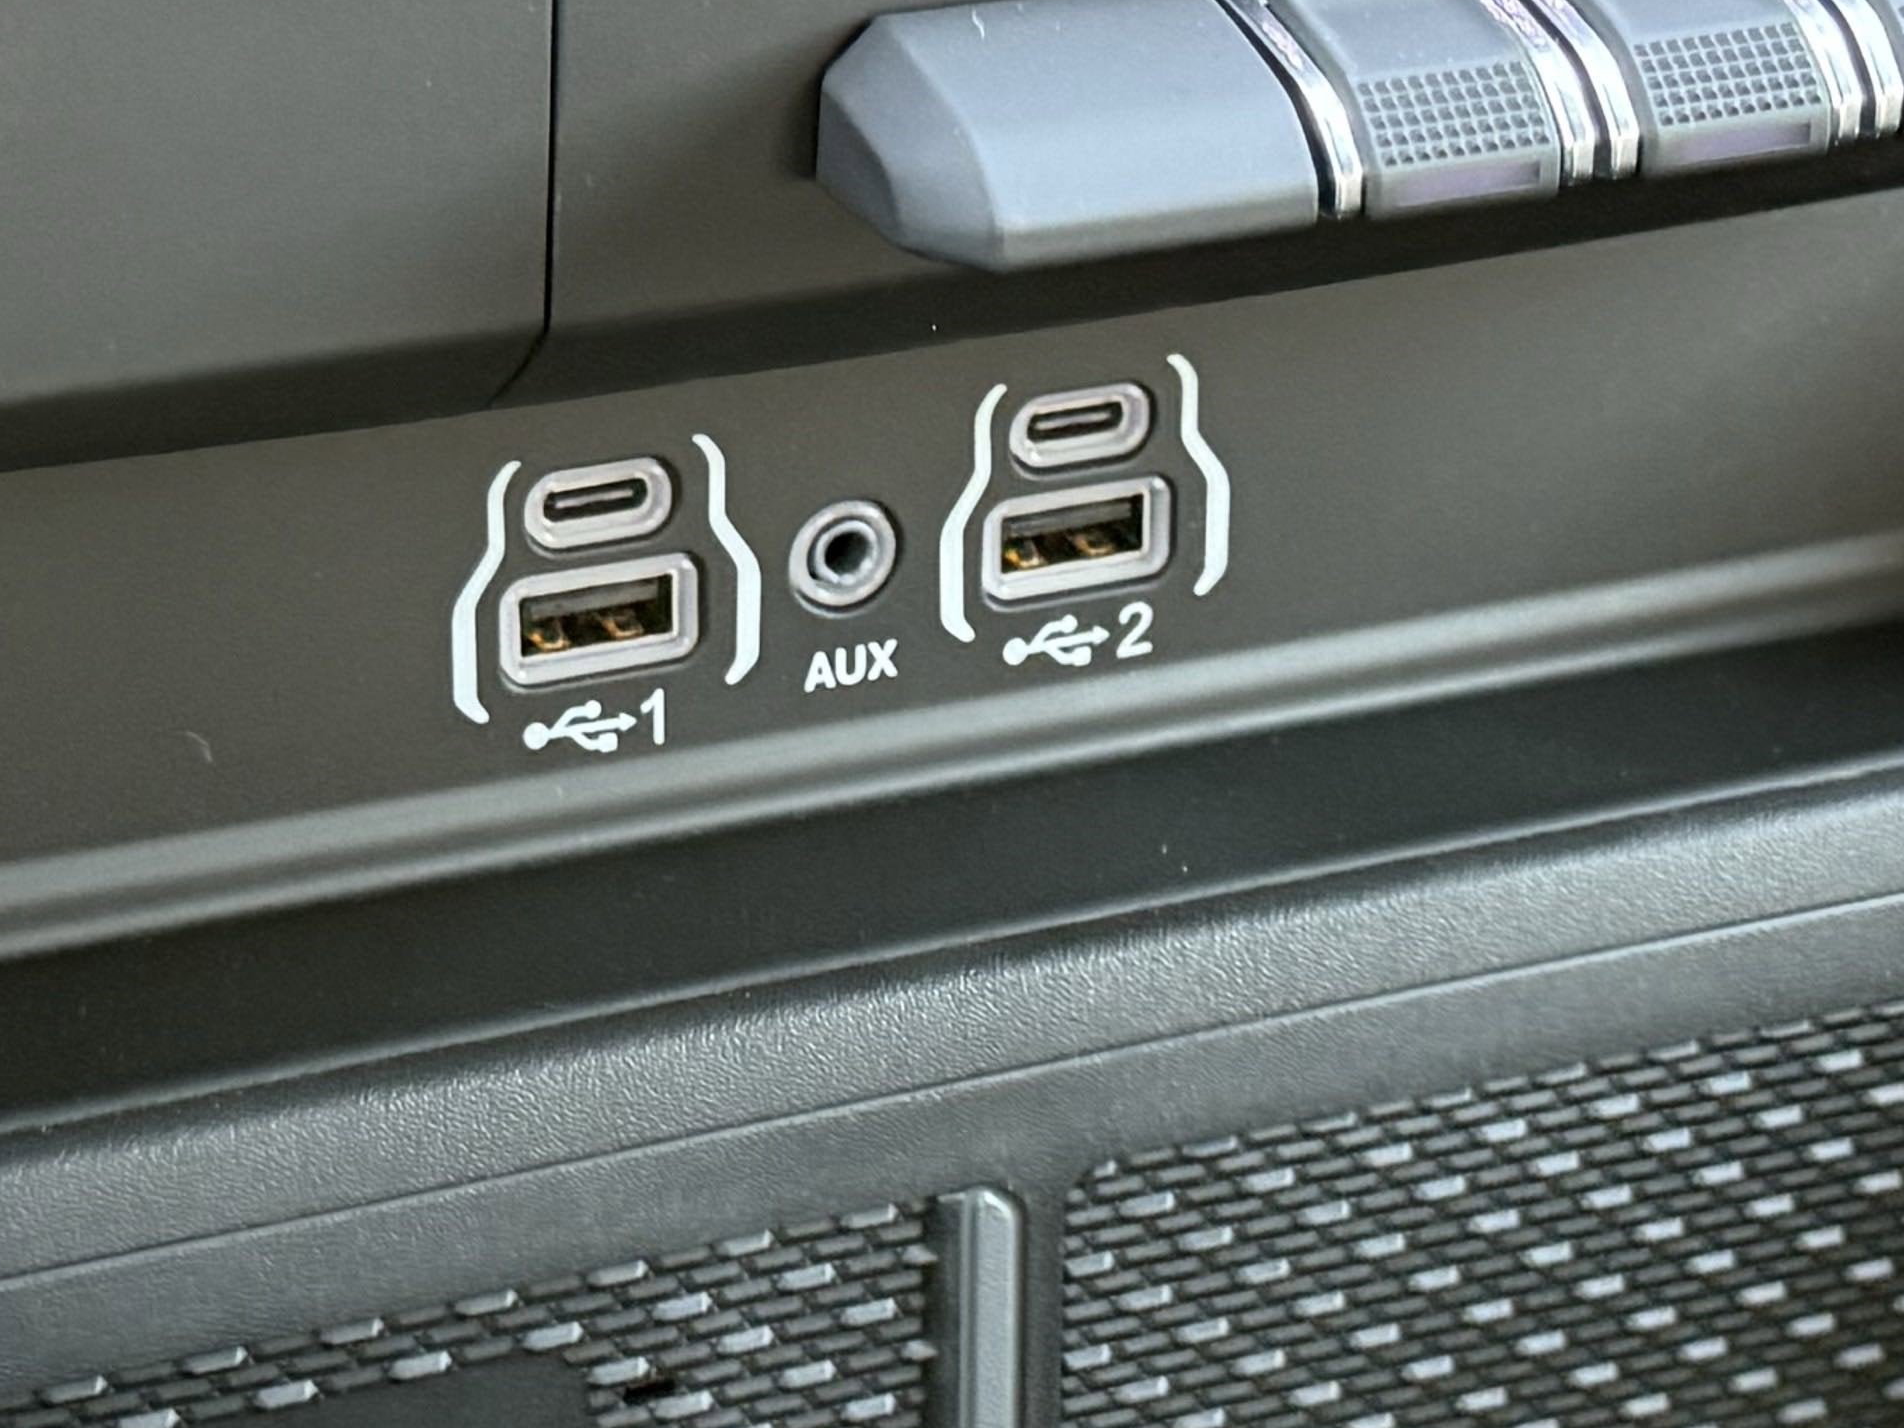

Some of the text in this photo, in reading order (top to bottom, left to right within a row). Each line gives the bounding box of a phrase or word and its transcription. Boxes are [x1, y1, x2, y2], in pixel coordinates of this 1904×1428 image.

[1115, 600, 1154, 659] 2
[803, 638, 899, 693] AUX
[639, 687, 666, 746] 1
